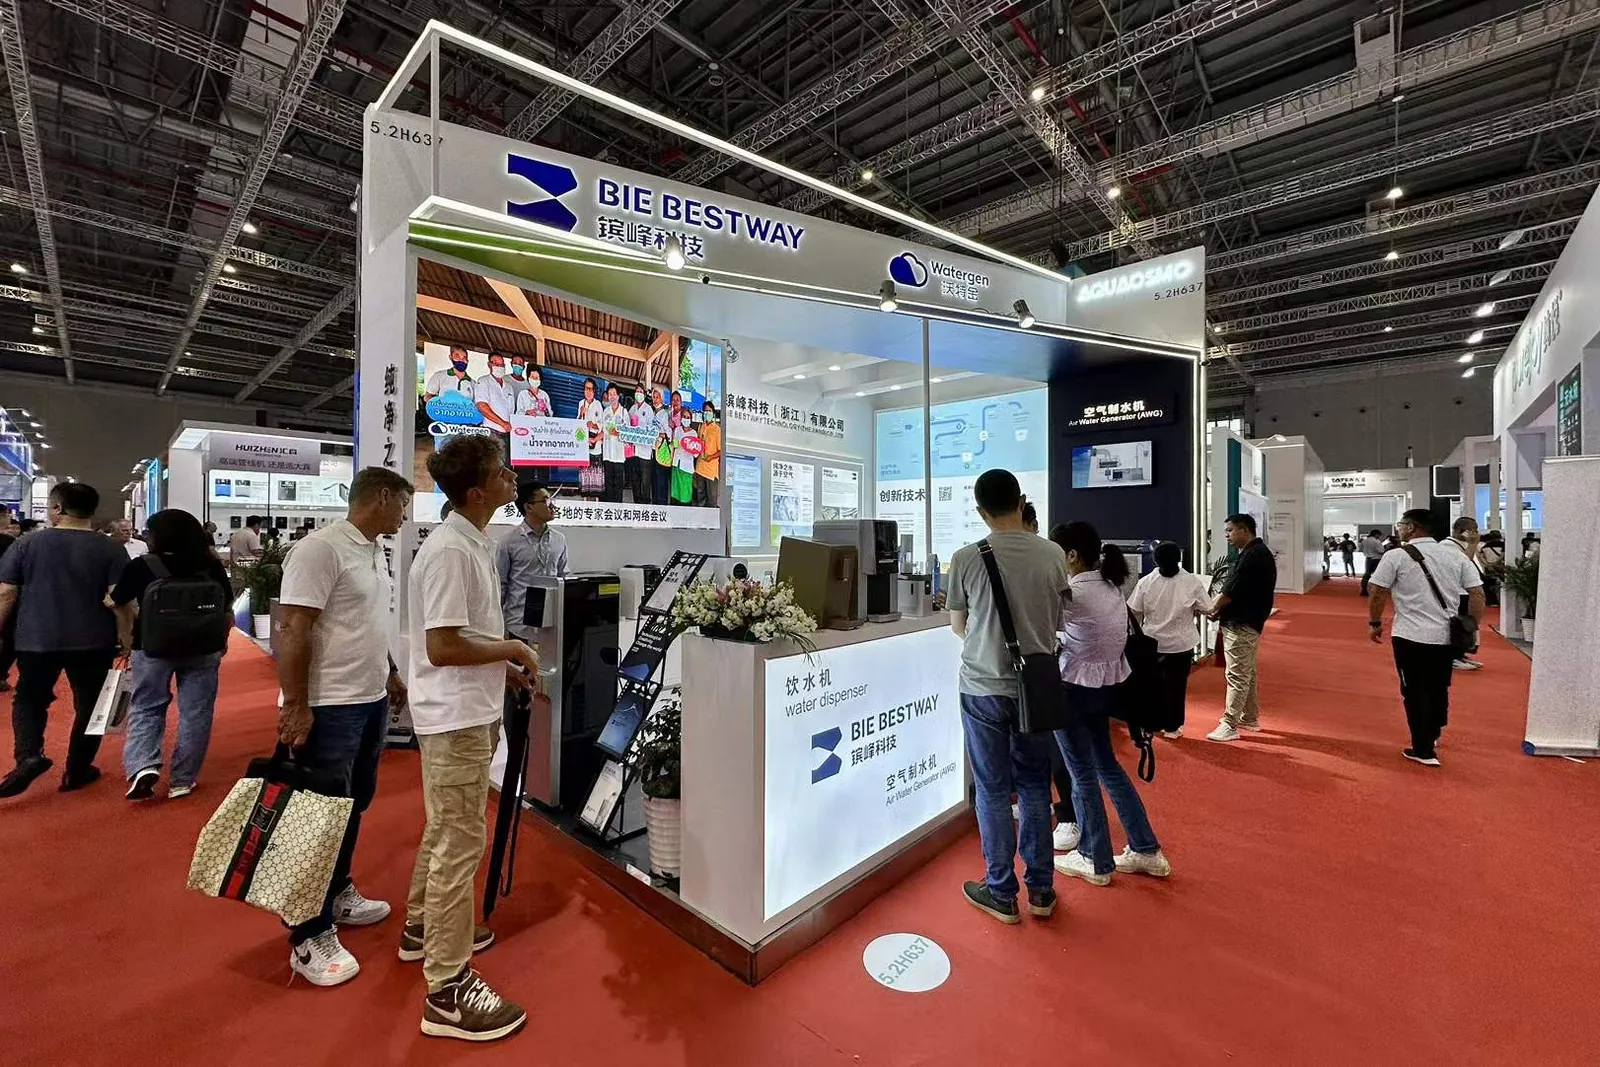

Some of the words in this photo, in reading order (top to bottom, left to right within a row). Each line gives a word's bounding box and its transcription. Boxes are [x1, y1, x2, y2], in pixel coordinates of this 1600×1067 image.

[598, 177, 653, 216] BIE
[661, 192, 806, 250] BESTWAY
[930, 259, 990, 287] Watergen
[1153, 281, 1203, 301] 5.2H637
[1078, 415, 1100, 425] Water
[1100, 411, 1137, 423] Generator
[1137, 409, 1163, 420] (AWG)
[1083, 399, 1146, 418] 空气制水机
[235, 444, 279, 454] HUIZHEN
[879, 488, 926, 503] 创新技术
[503, 503, 668, 523] 参各地的专家会议和网络会议
[785, 667, 832, 697] 饮水机
[785, 697, 818, 717] water
[819, 683, 868, 708] dispenser
[851, 715, 875, 742] BIE
[878, 693, 939, 732] BESTWAY
[850, 734, 897, 767] 镔峰科技
[885, 753, 938, 792] 空气制水机
[885, 795, 895, 806] Air
[895, 785, 913, 801] Water
[878, 936, 931, 985] 5.2H637
